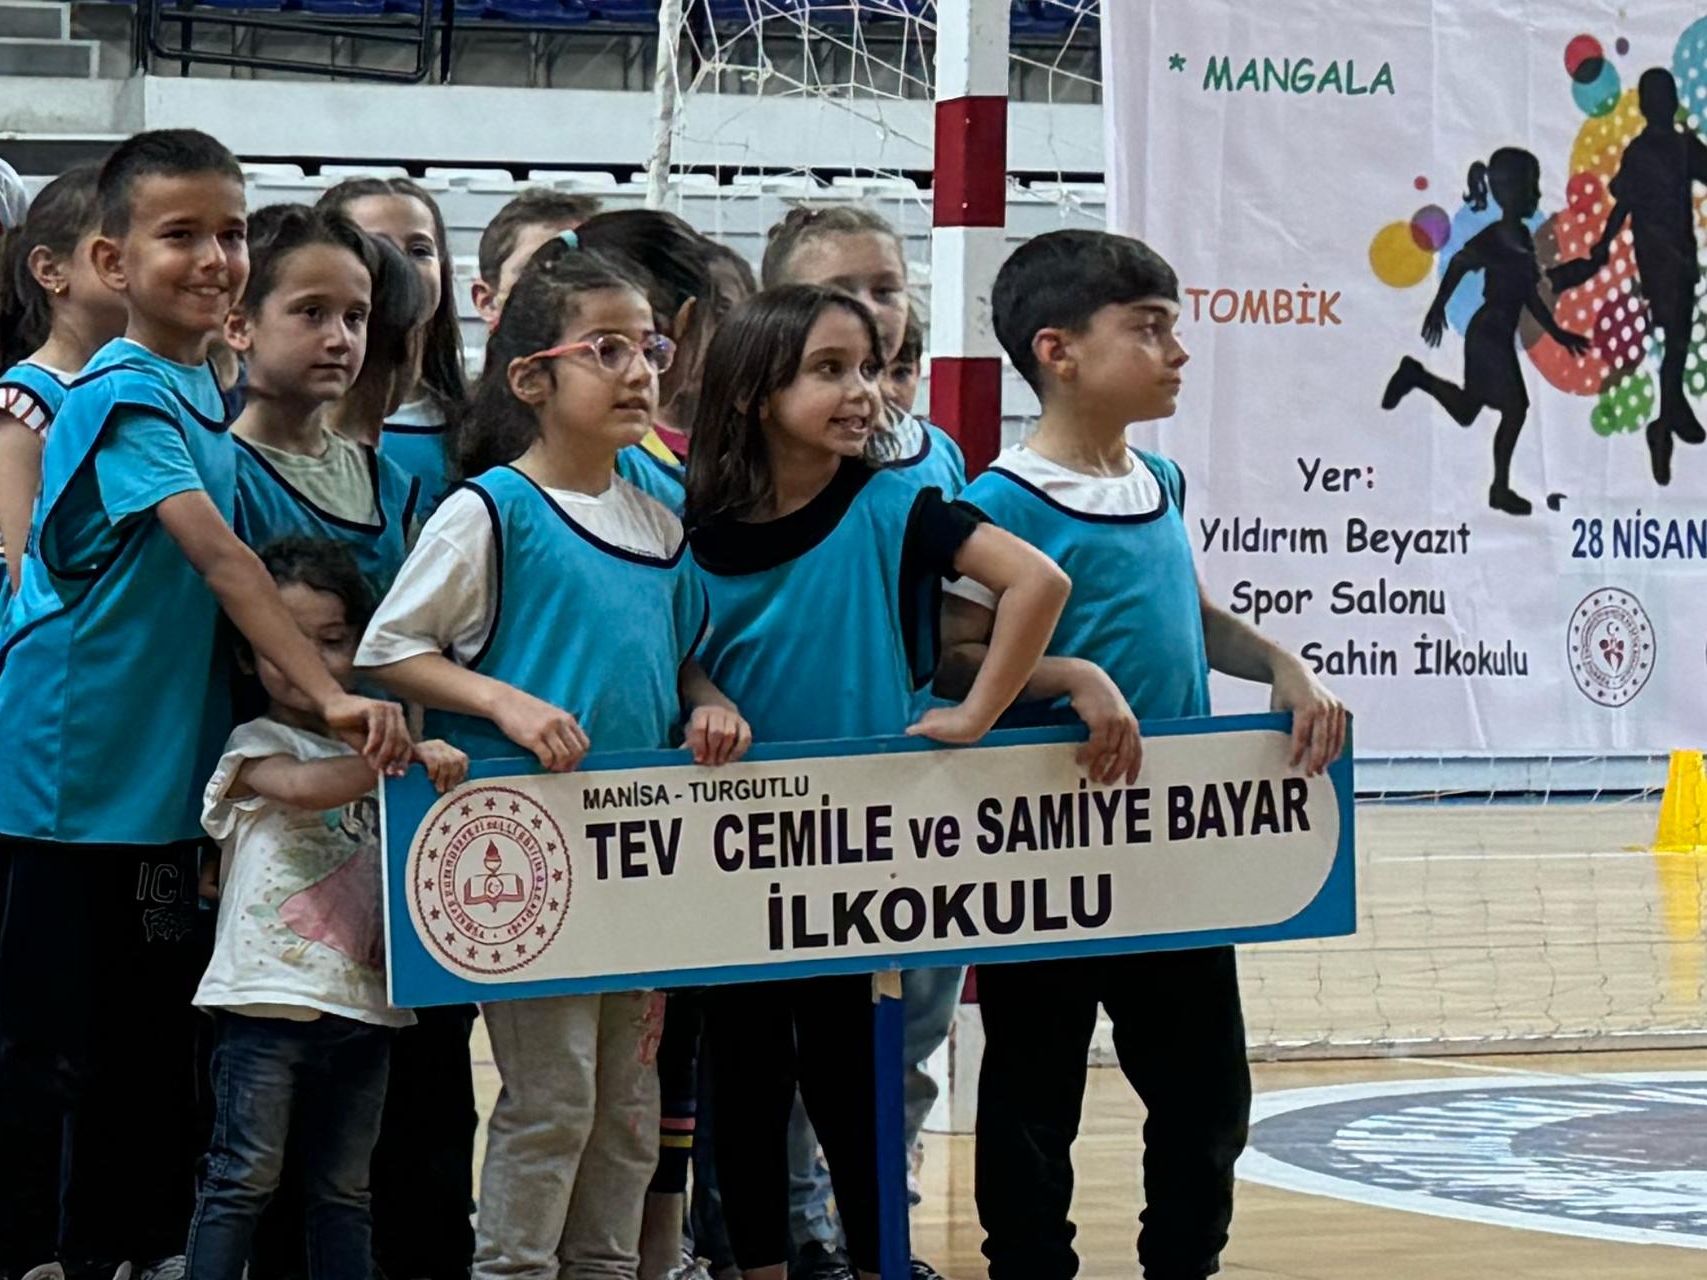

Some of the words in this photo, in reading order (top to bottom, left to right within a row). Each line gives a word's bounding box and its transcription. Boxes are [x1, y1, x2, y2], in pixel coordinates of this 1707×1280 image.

[1202, 55, 1396, 96] MANGALA
[1184, 282, 1342, 326] TOMBİK
[1297, 457, 1375, 493] Yer:
[1200, 516, 1328, 554] Yıldırım
[1346, 517, 1471, 565] Beyazıt
[1571, 519, 1604, 560] 28
[1613, 509, 1707, 560] NİSAN
[1229, 580, 1313, 621] Spor
[1329, 578, 1446, 615] Salonu
[1413, 632, 1529, 677] İlkokulu
[582, 781, 670, 810] MANİSA
[688, 775, 810, 803] TURGUTLU
[585, 817, 684, 880] TEV
[713, 793, 894, 873] CEMİLE
[908, 815, 961, 859] ve
[976, 777, 1153, 855] SAMİYE
[1167, 777, 1312, 841] BAYAR
[768, 873, 1113, 951] İLKOKULU
